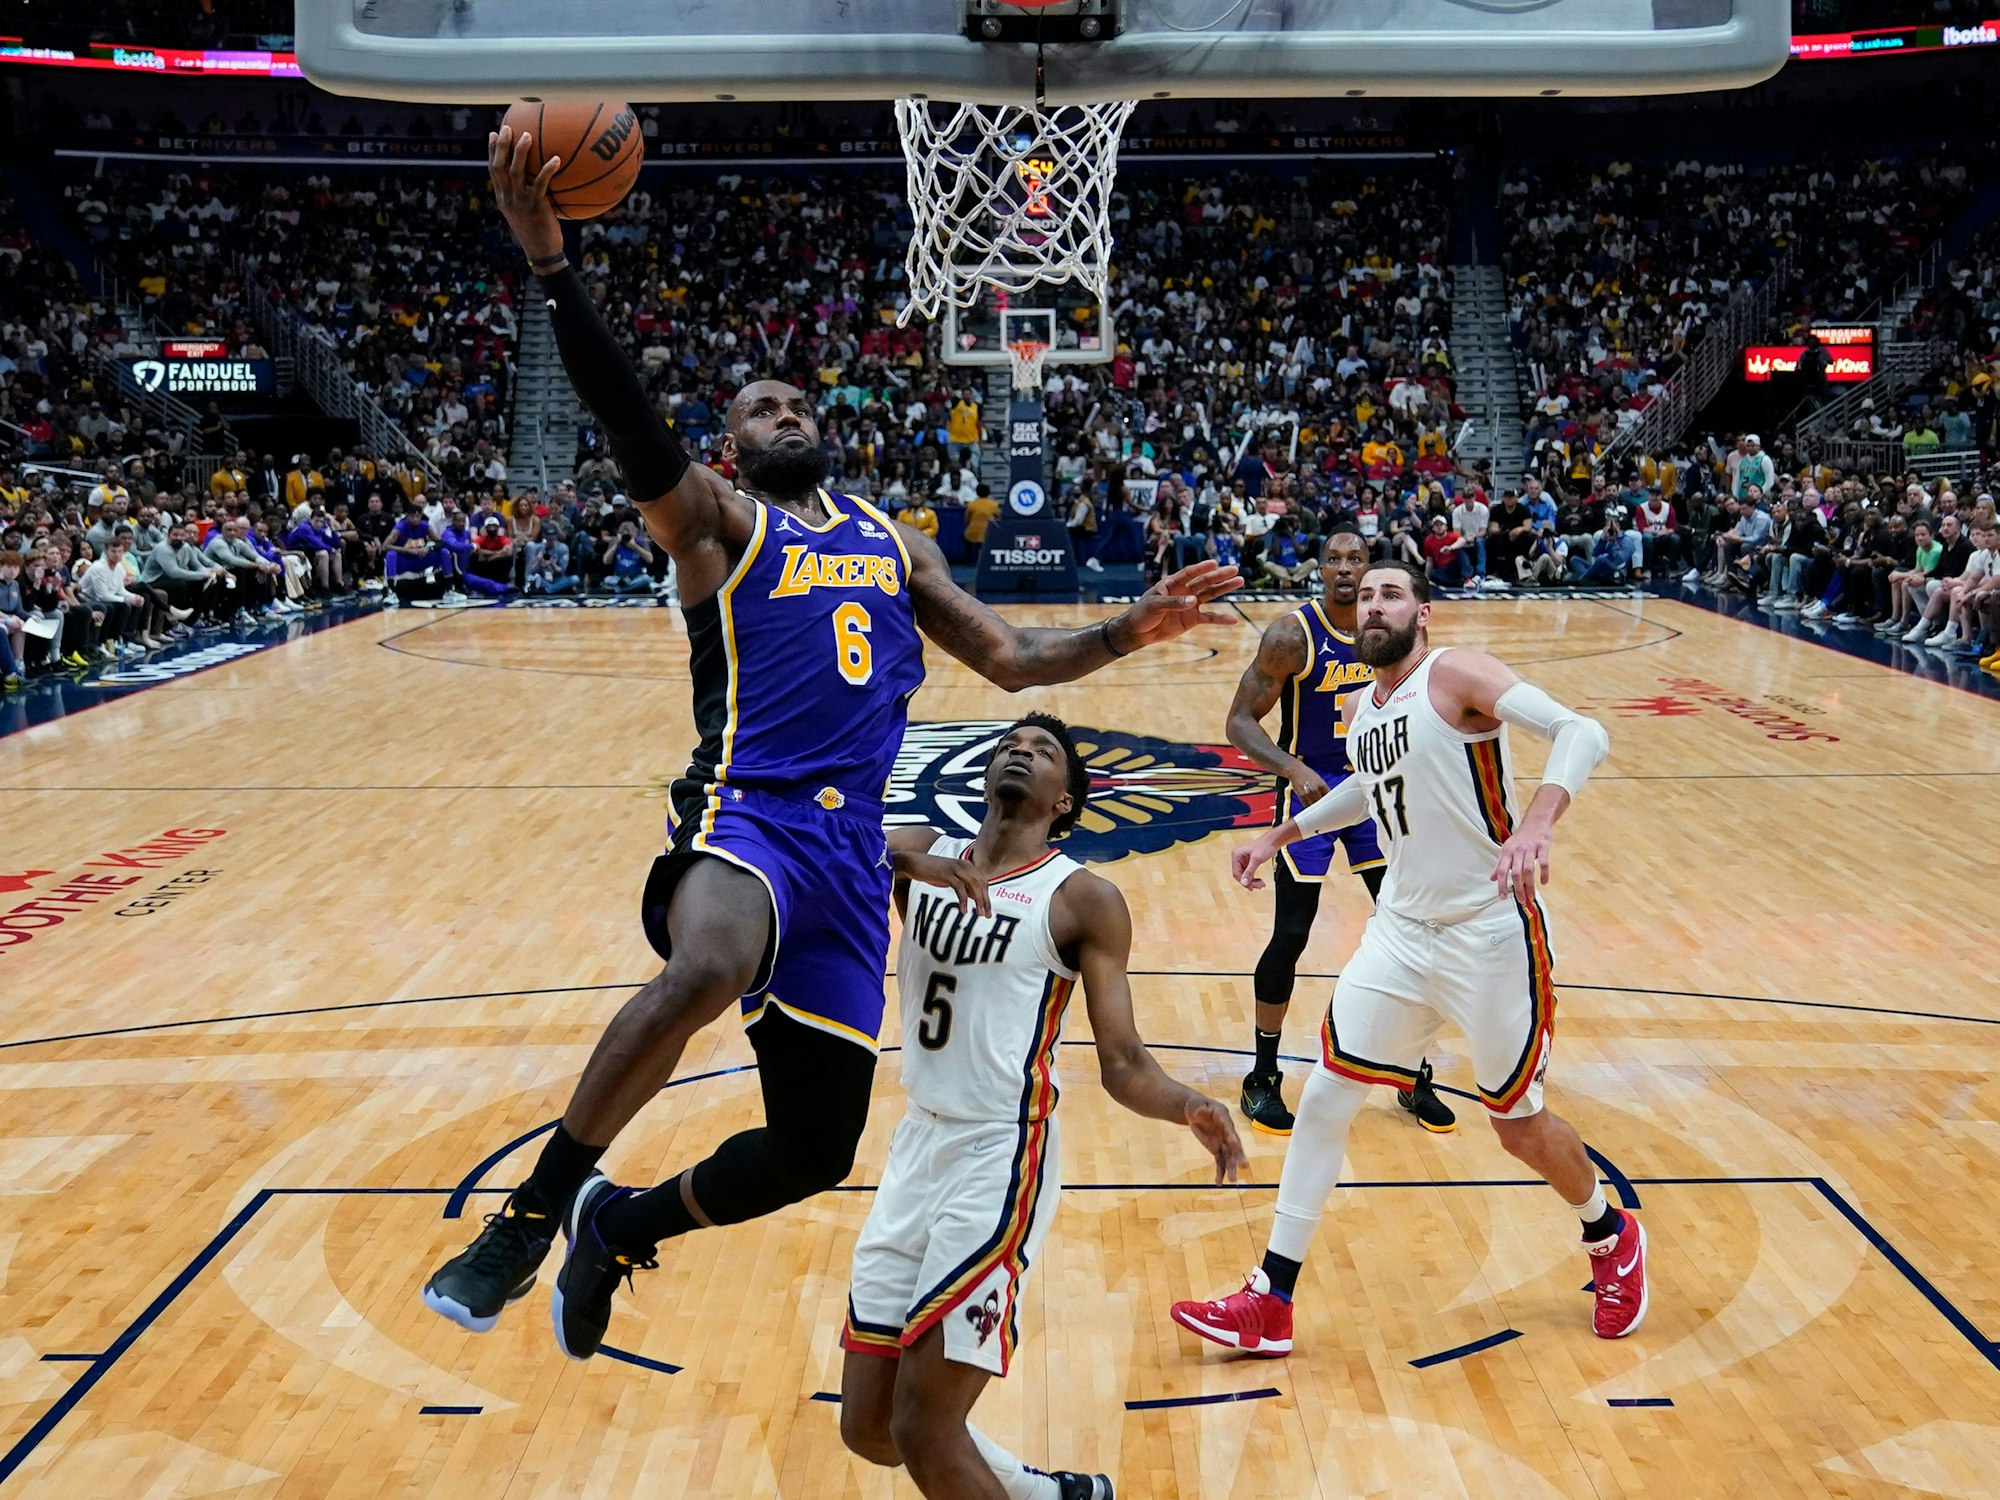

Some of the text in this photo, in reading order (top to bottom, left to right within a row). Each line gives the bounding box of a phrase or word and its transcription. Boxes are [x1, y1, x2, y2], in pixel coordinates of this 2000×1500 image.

[1942, 25, 1998, 46] ibotta
[113, 48, 165, 70] ibotta
[158, 137, 277, 151] BETRIVERS
[661, 142, 774, 155] BETRIVERS
[1119, 137, 1227, 149] BETRIVERS
[1294, 135, 1406, 148] BETRIVERS
[172, 342, 220, 351] EMERGENCY
[187, 350, 205, 358] EXIT
[168, 363, 256, 380] FANDUEL
[169, 380, 257, 392] SPORTSBOOK
[1013, 422, 1039, 431] SEAT
[1012, 431, 1040, 443] GEEK
[990, 549, 1065, 565] TISSOT
[768, 545, 900, 599] LAKERS
[832, 601, 873, 686] 6
[1314, 660, 1377, 692] LAKE
[1393, 691, 1417, 704] ibotta
[1356, 714, 1410, 775] NOLA
[1371, 774, 1411, 842] 17
[83, 828, 227, 868] KING
[114, 869, 224, 917] CENTER
[995, 886, 1033, 905] ibotta
[912, 892, 1022, 967] NOLA
[918, 970, 958, 1051] 5
